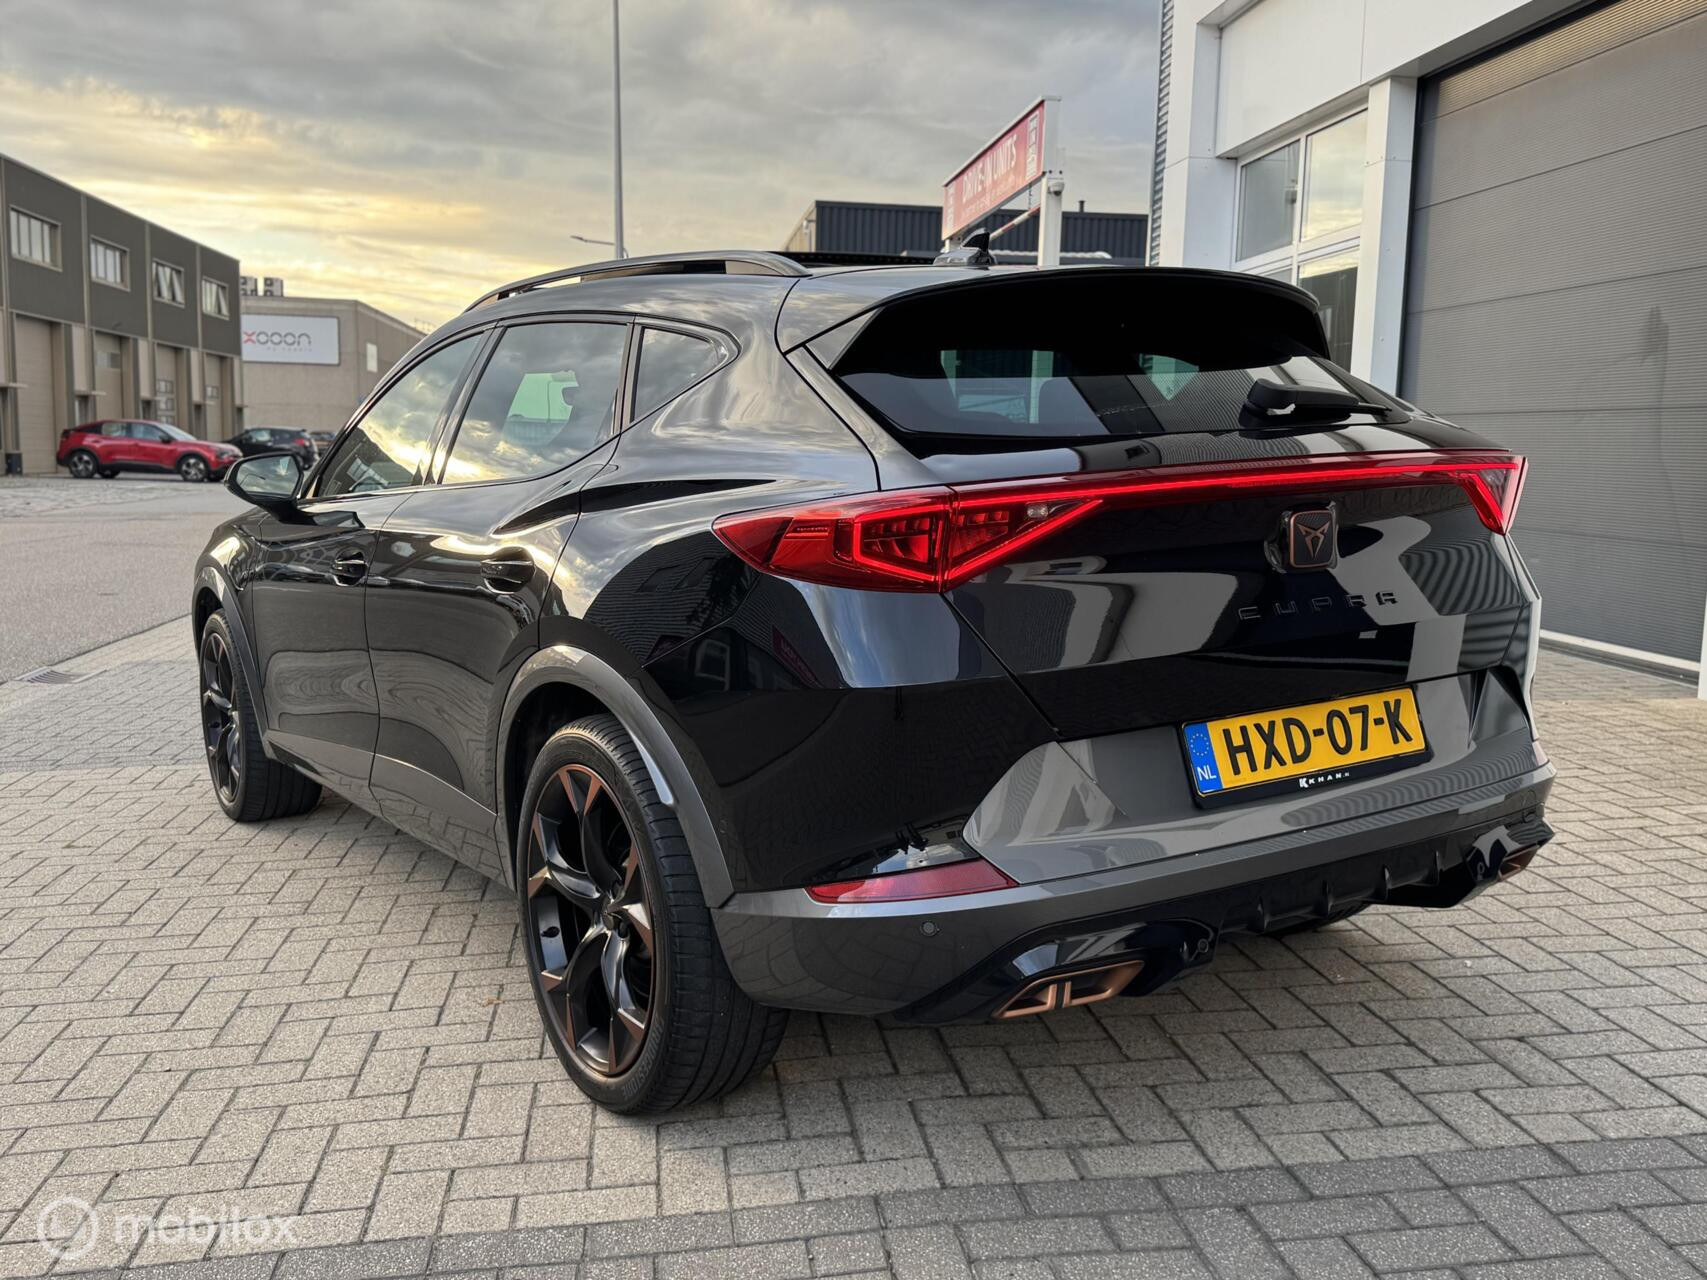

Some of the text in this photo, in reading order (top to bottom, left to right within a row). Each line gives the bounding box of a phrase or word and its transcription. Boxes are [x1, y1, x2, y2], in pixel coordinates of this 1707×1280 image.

[993, 133, 1018, 180] UNITS
[1222, 698, 1413, 776] HXD-07-K
[1197, 765, 1216, 781] NL
